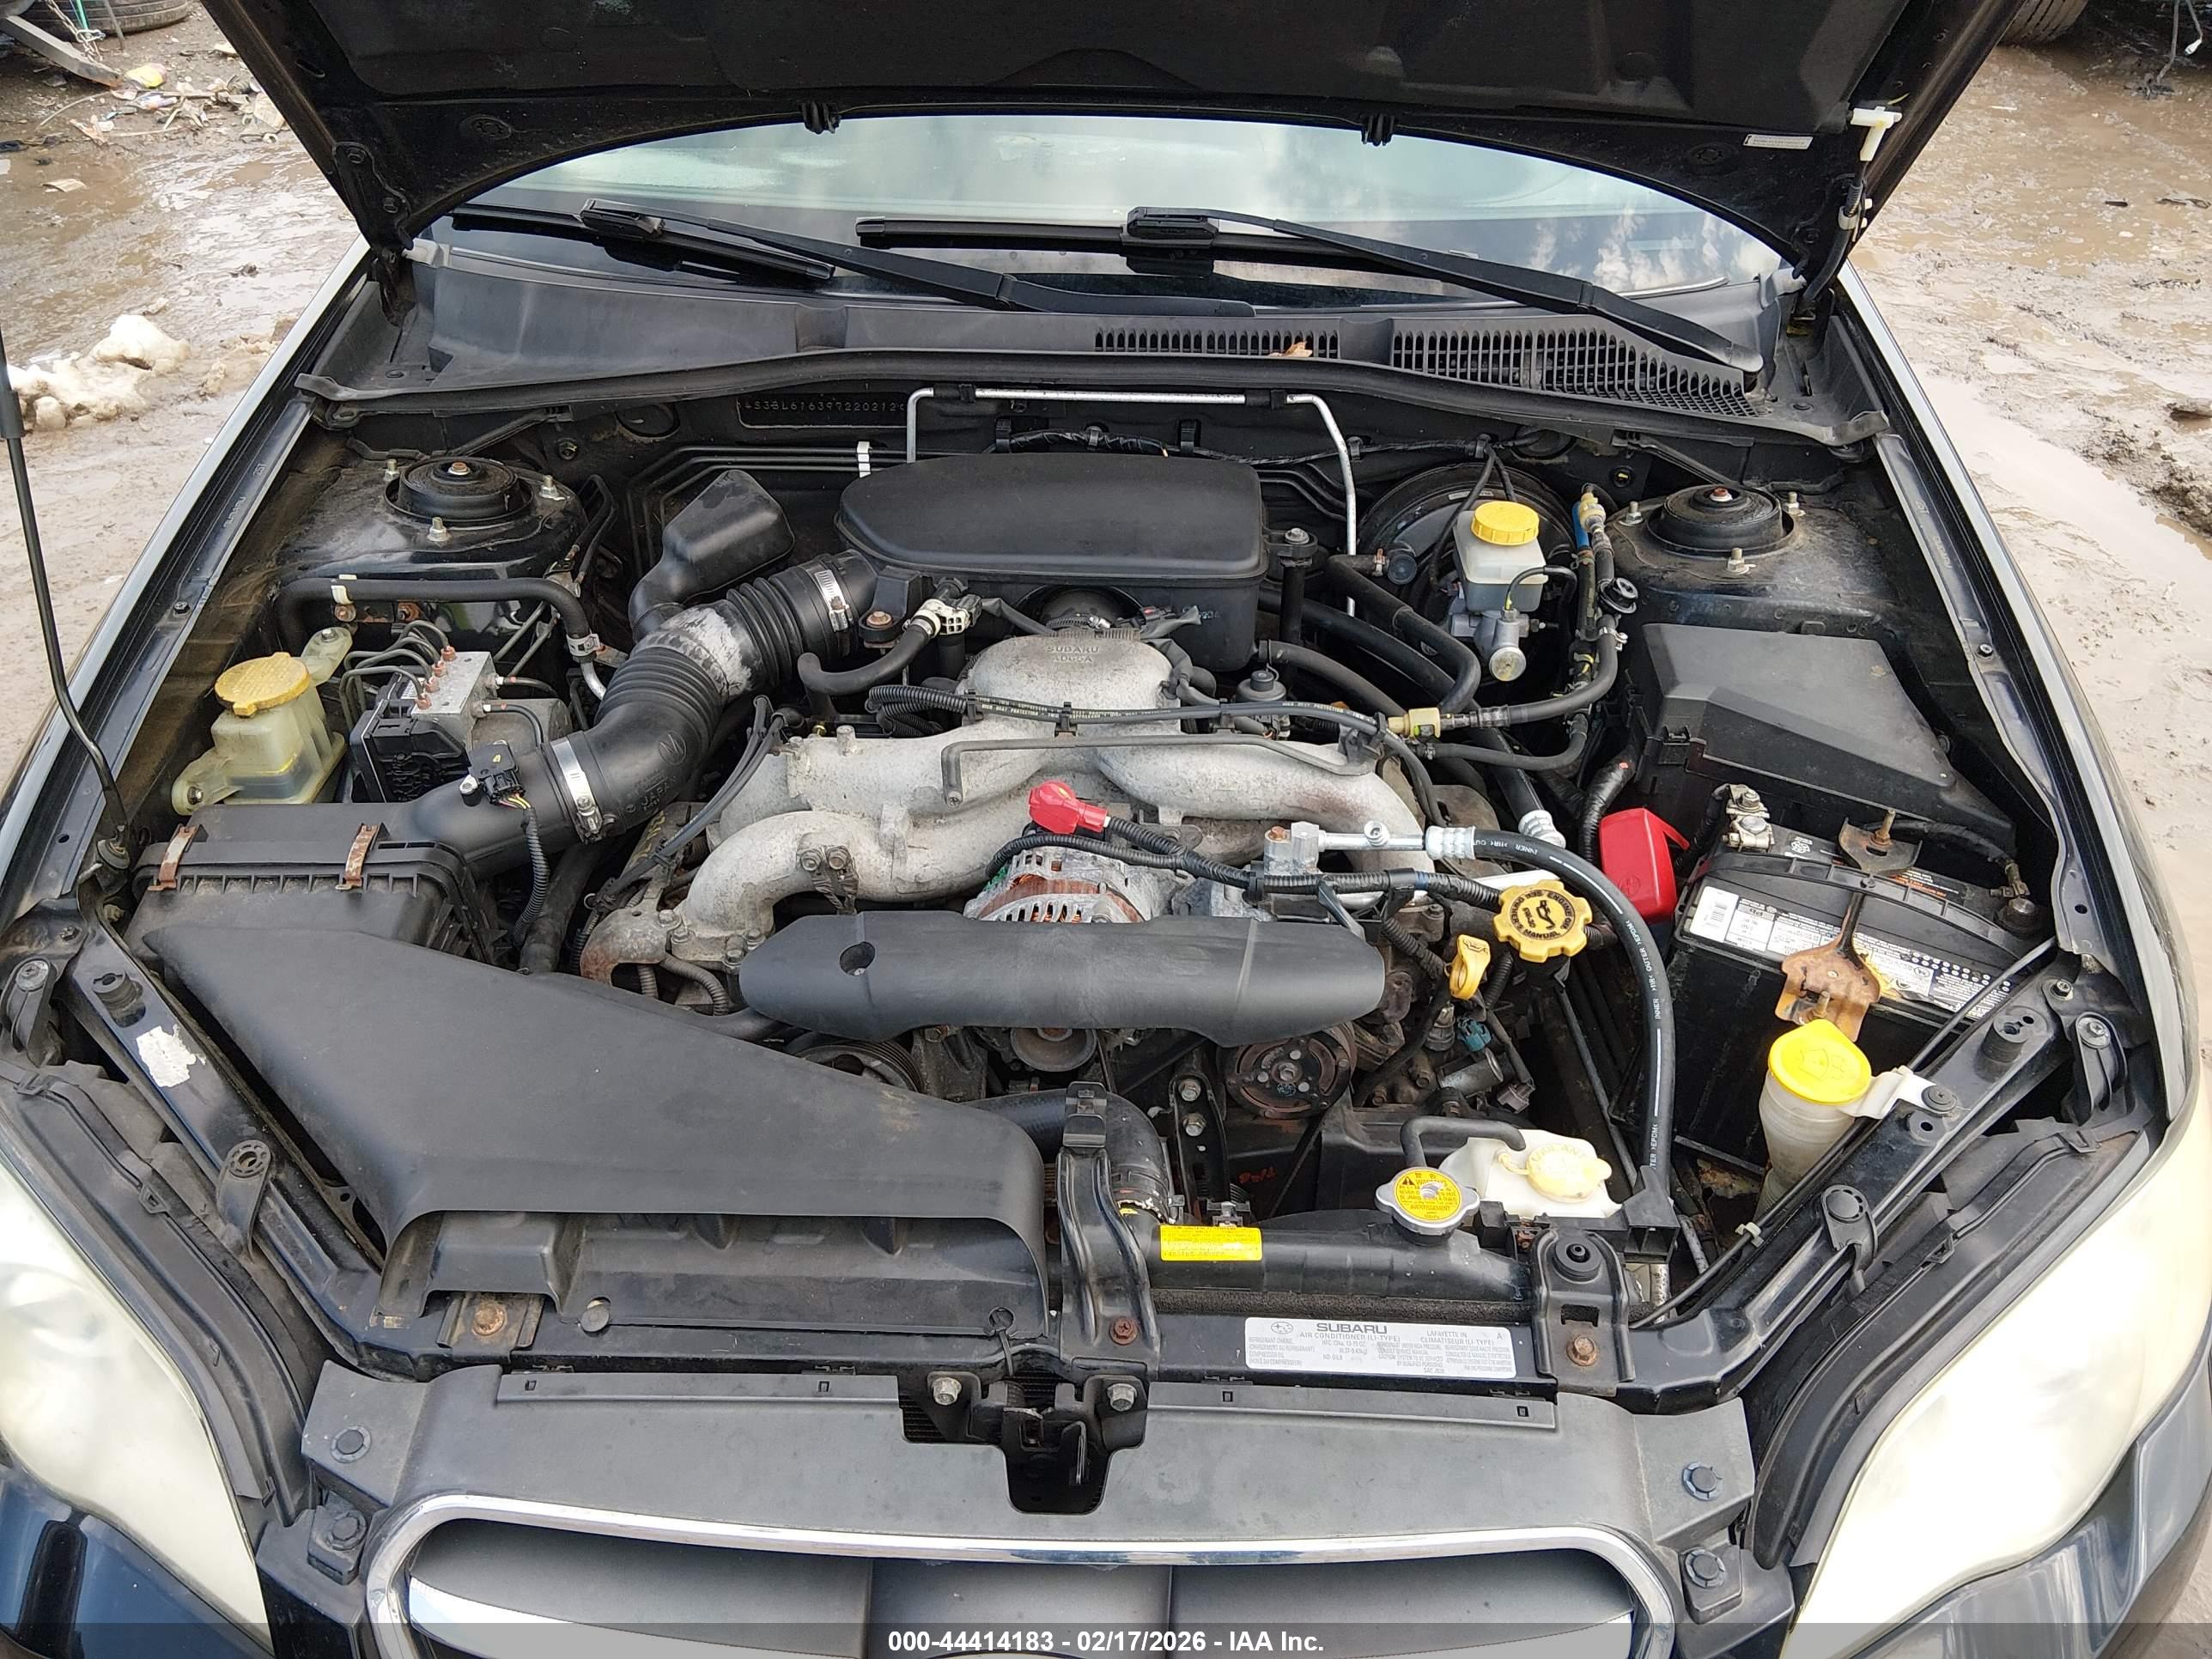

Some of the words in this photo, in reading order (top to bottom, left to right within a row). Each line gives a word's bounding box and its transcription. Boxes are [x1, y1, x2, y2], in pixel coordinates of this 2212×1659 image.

[1523, 928, 1560, 939] MANUAL
[1639, 947, 1652, 971] OUTER
[1316, 1322, 1388, 1334] SUBARU
